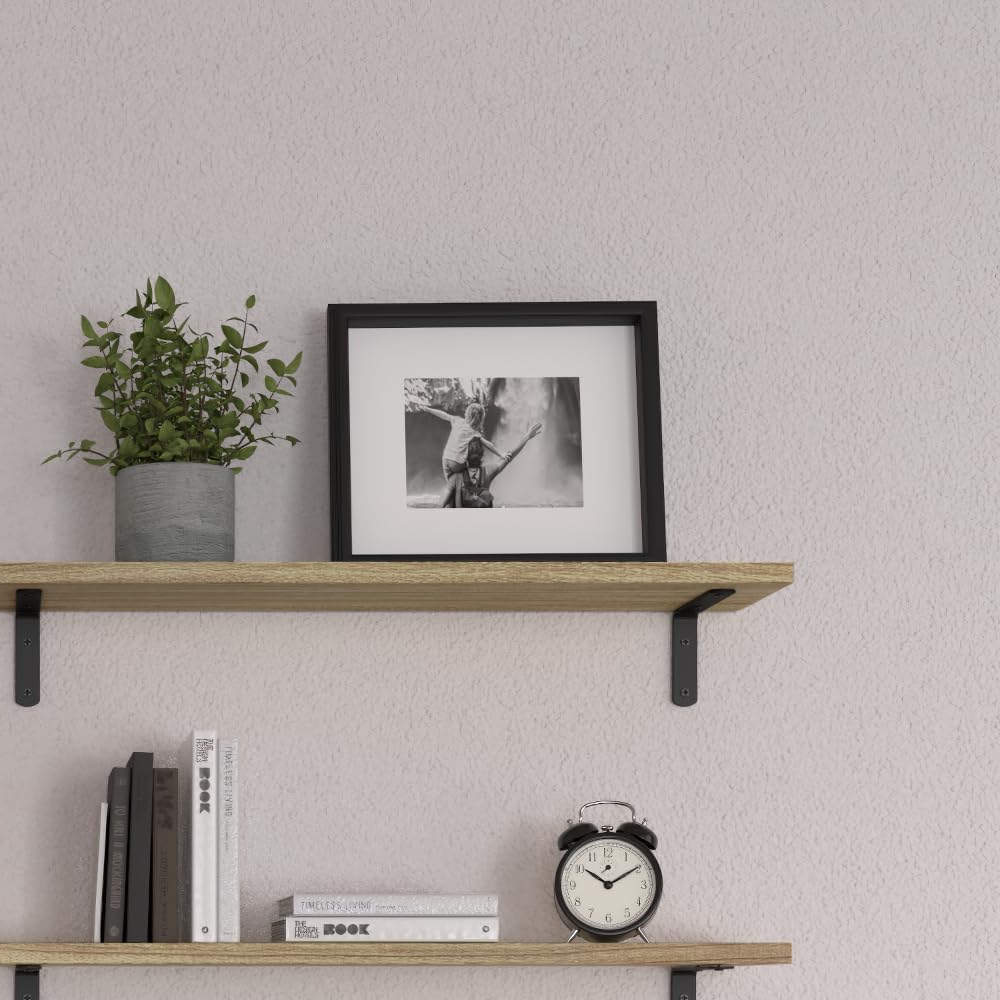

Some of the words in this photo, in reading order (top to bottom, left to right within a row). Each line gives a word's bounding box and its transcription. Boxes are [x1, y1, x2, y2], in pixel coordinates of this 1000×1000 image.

[199, 767, 211, 814] BOOK
[588, 852, 596, 862] 11
[603, 847, 613, 859] 12
[569, 880, 577, 890] 9
[640, 879, 647, 890] 3
[574, 897, 582, 907] 8
[636, 896, 642, 907] 4
[588, 907, 595, 918] 7
[605, 913, 612, 923] 6
[623, 907, 631, 918] 5
[323, 923, 370, 935] BOOK
